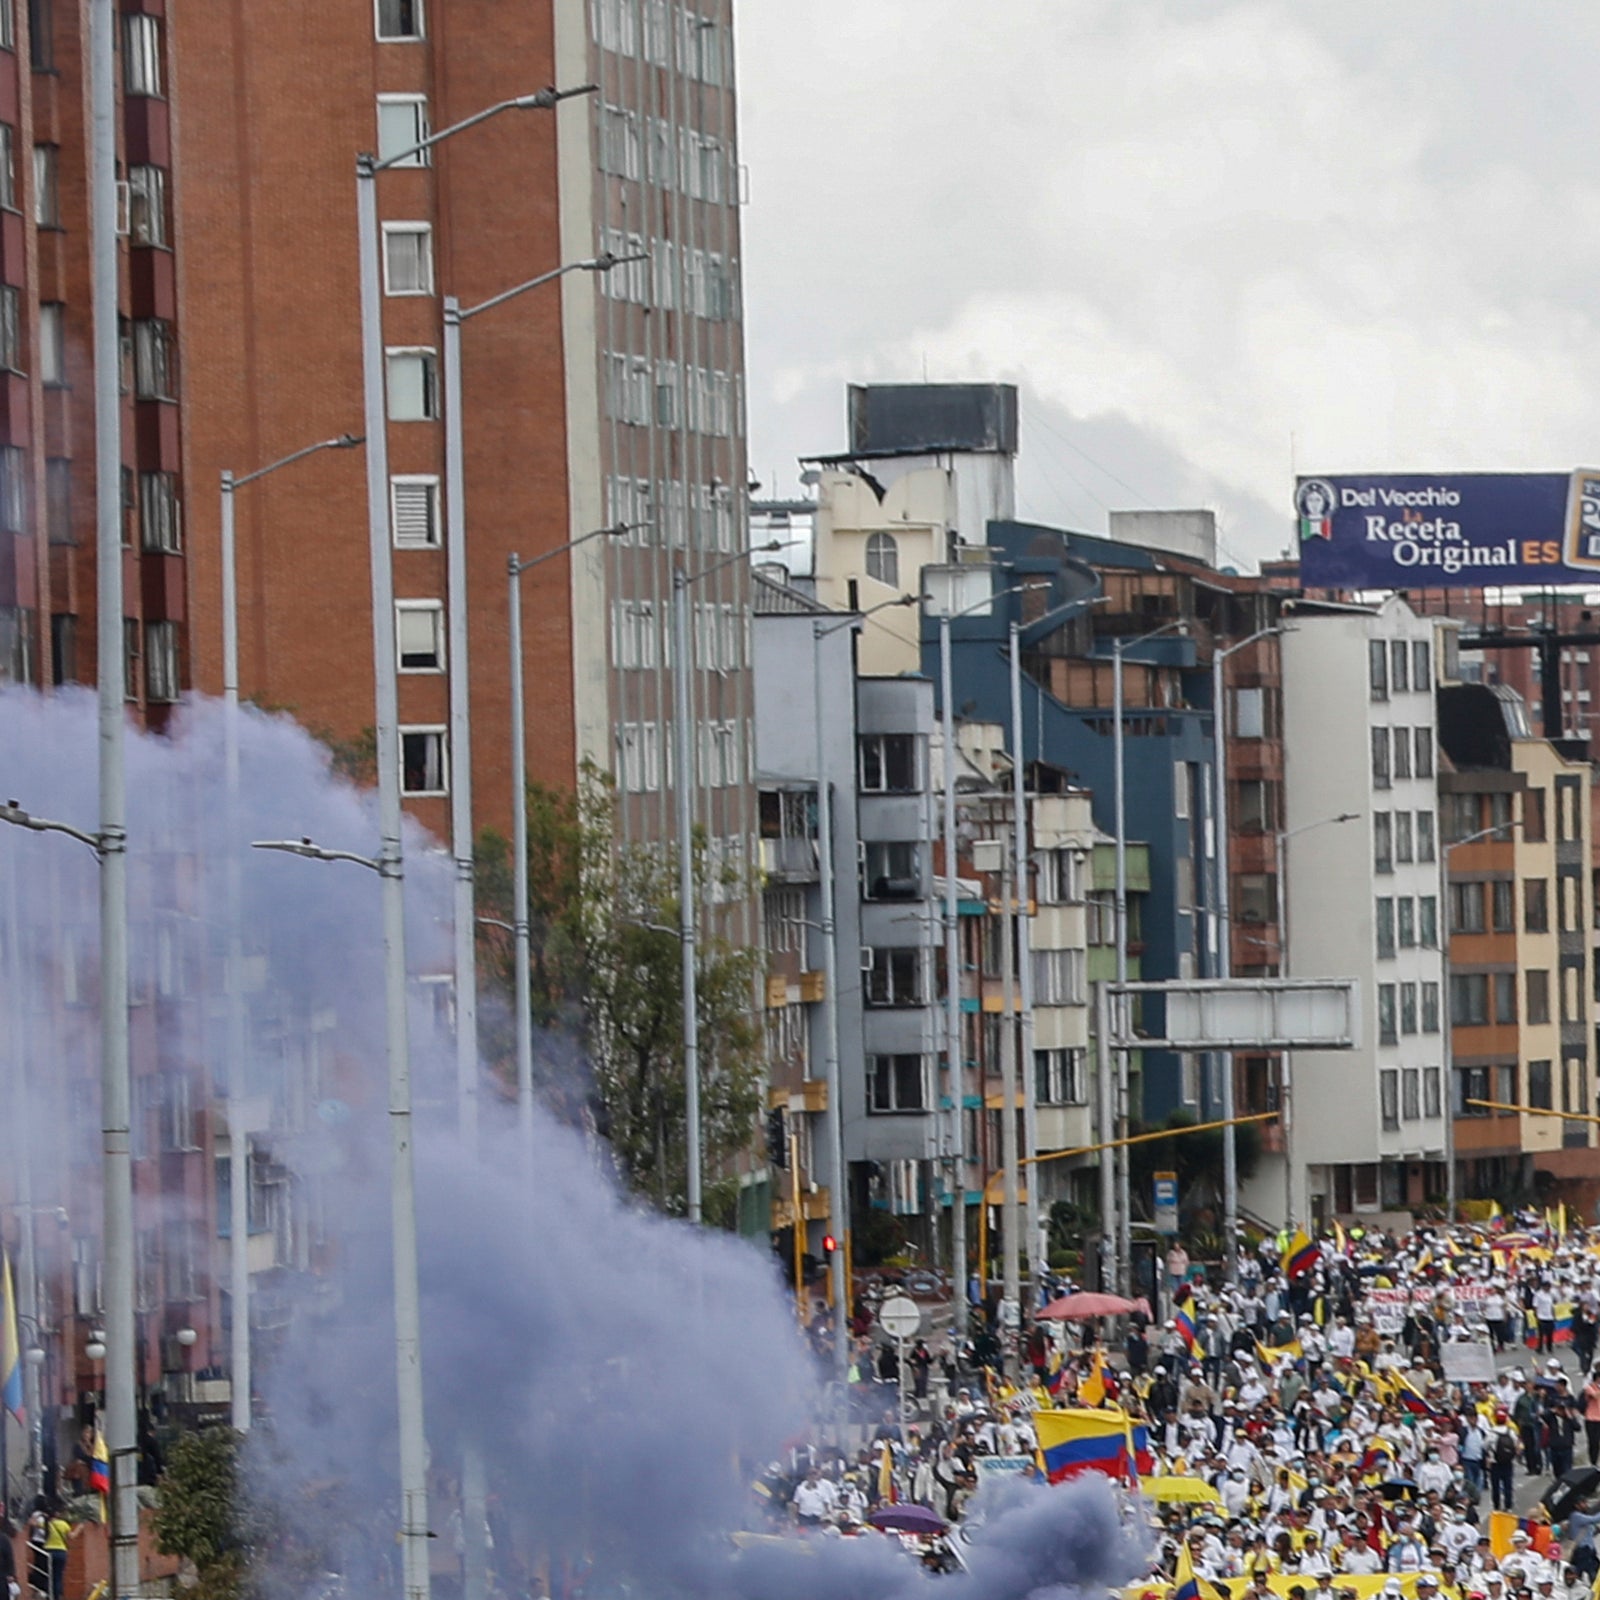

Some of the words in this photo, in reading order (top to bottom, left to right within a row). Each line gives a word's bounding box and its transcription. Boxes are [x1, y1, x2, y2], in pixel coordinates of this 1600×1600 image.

[1341, 488, 1375, 507] Del
[1378, 486, 1460, 507] Vecchio
[1365, 515, 1462, 541] Receta
[1393, 539, 1517, 574] Original
[1522, 541, 1560, 564] ES
